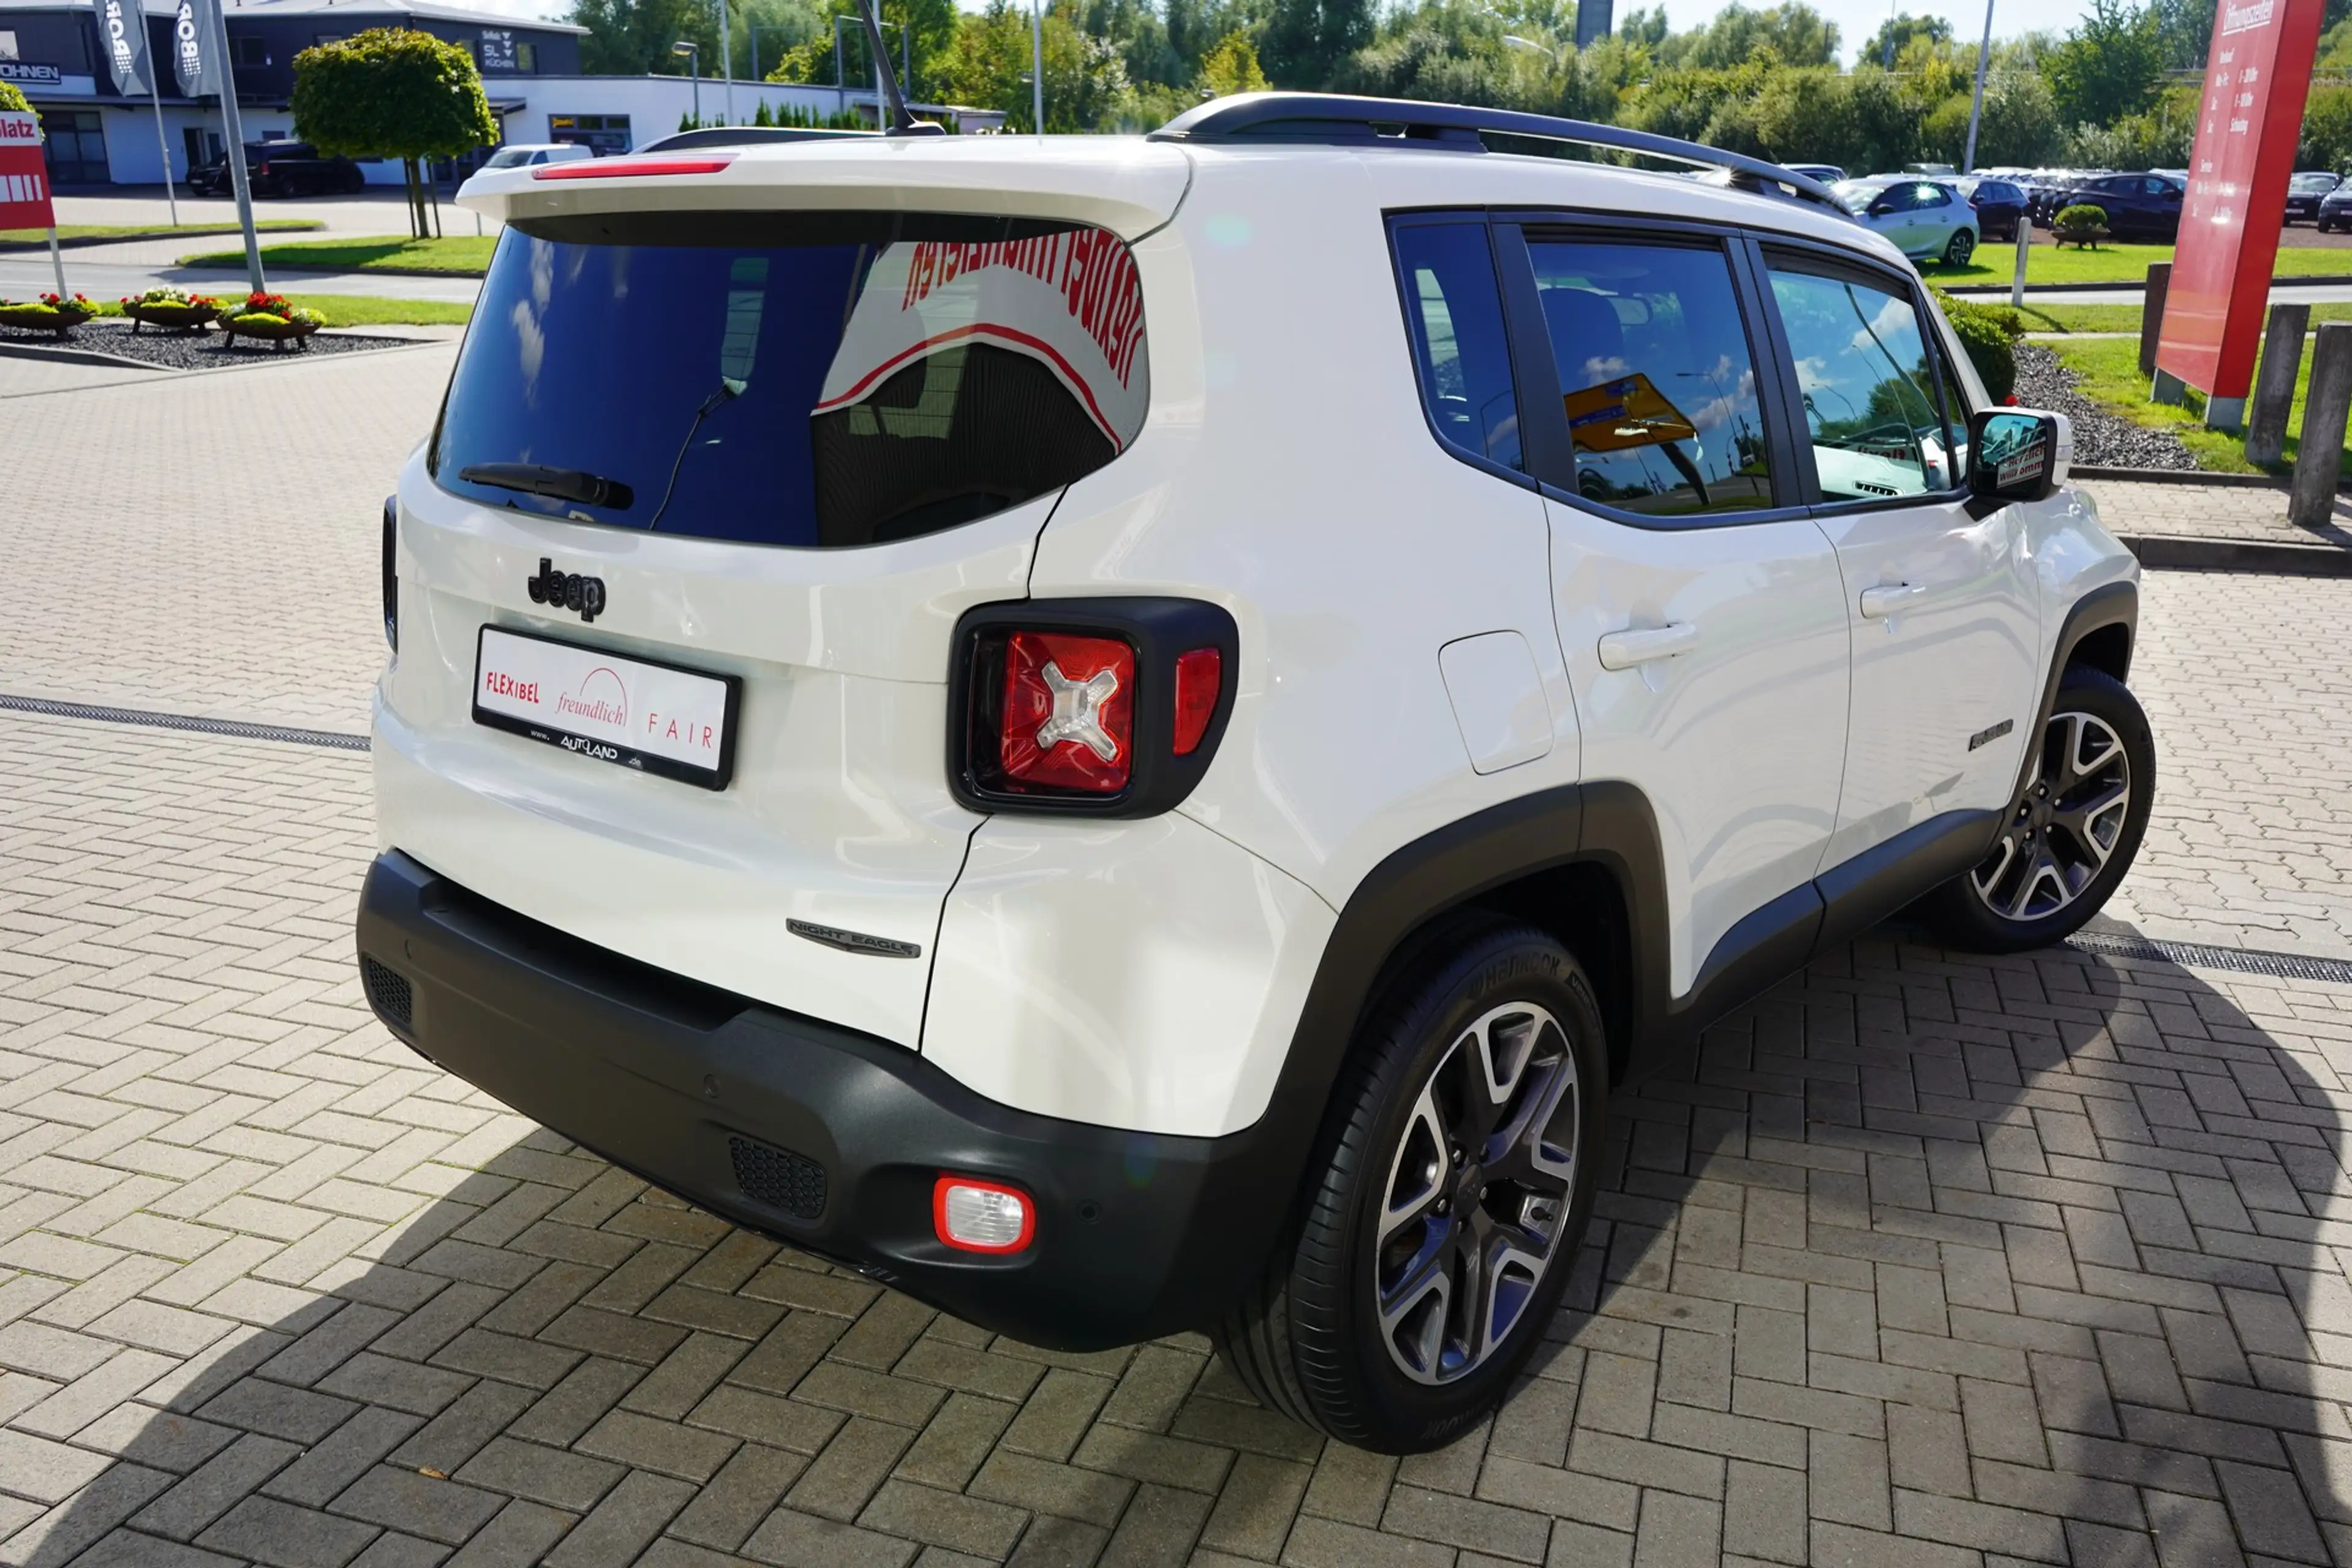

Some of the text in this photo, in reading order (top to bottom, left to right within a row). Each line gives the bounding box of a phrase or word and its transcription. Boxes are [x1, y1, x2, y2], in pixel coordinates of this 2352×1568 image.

[0, 64, 59, 79] OHNEN
[0, 119, 35, 138] latz
[528, 557, 606, 623] Jeep
[486, 671, 540, 704] FLEXIBEL
[554, 692, 624, 726] freundlich
[560, 736, 618, 760] AUTOLAND
[789, 921, 914, 956] NIGHT EAGLE
